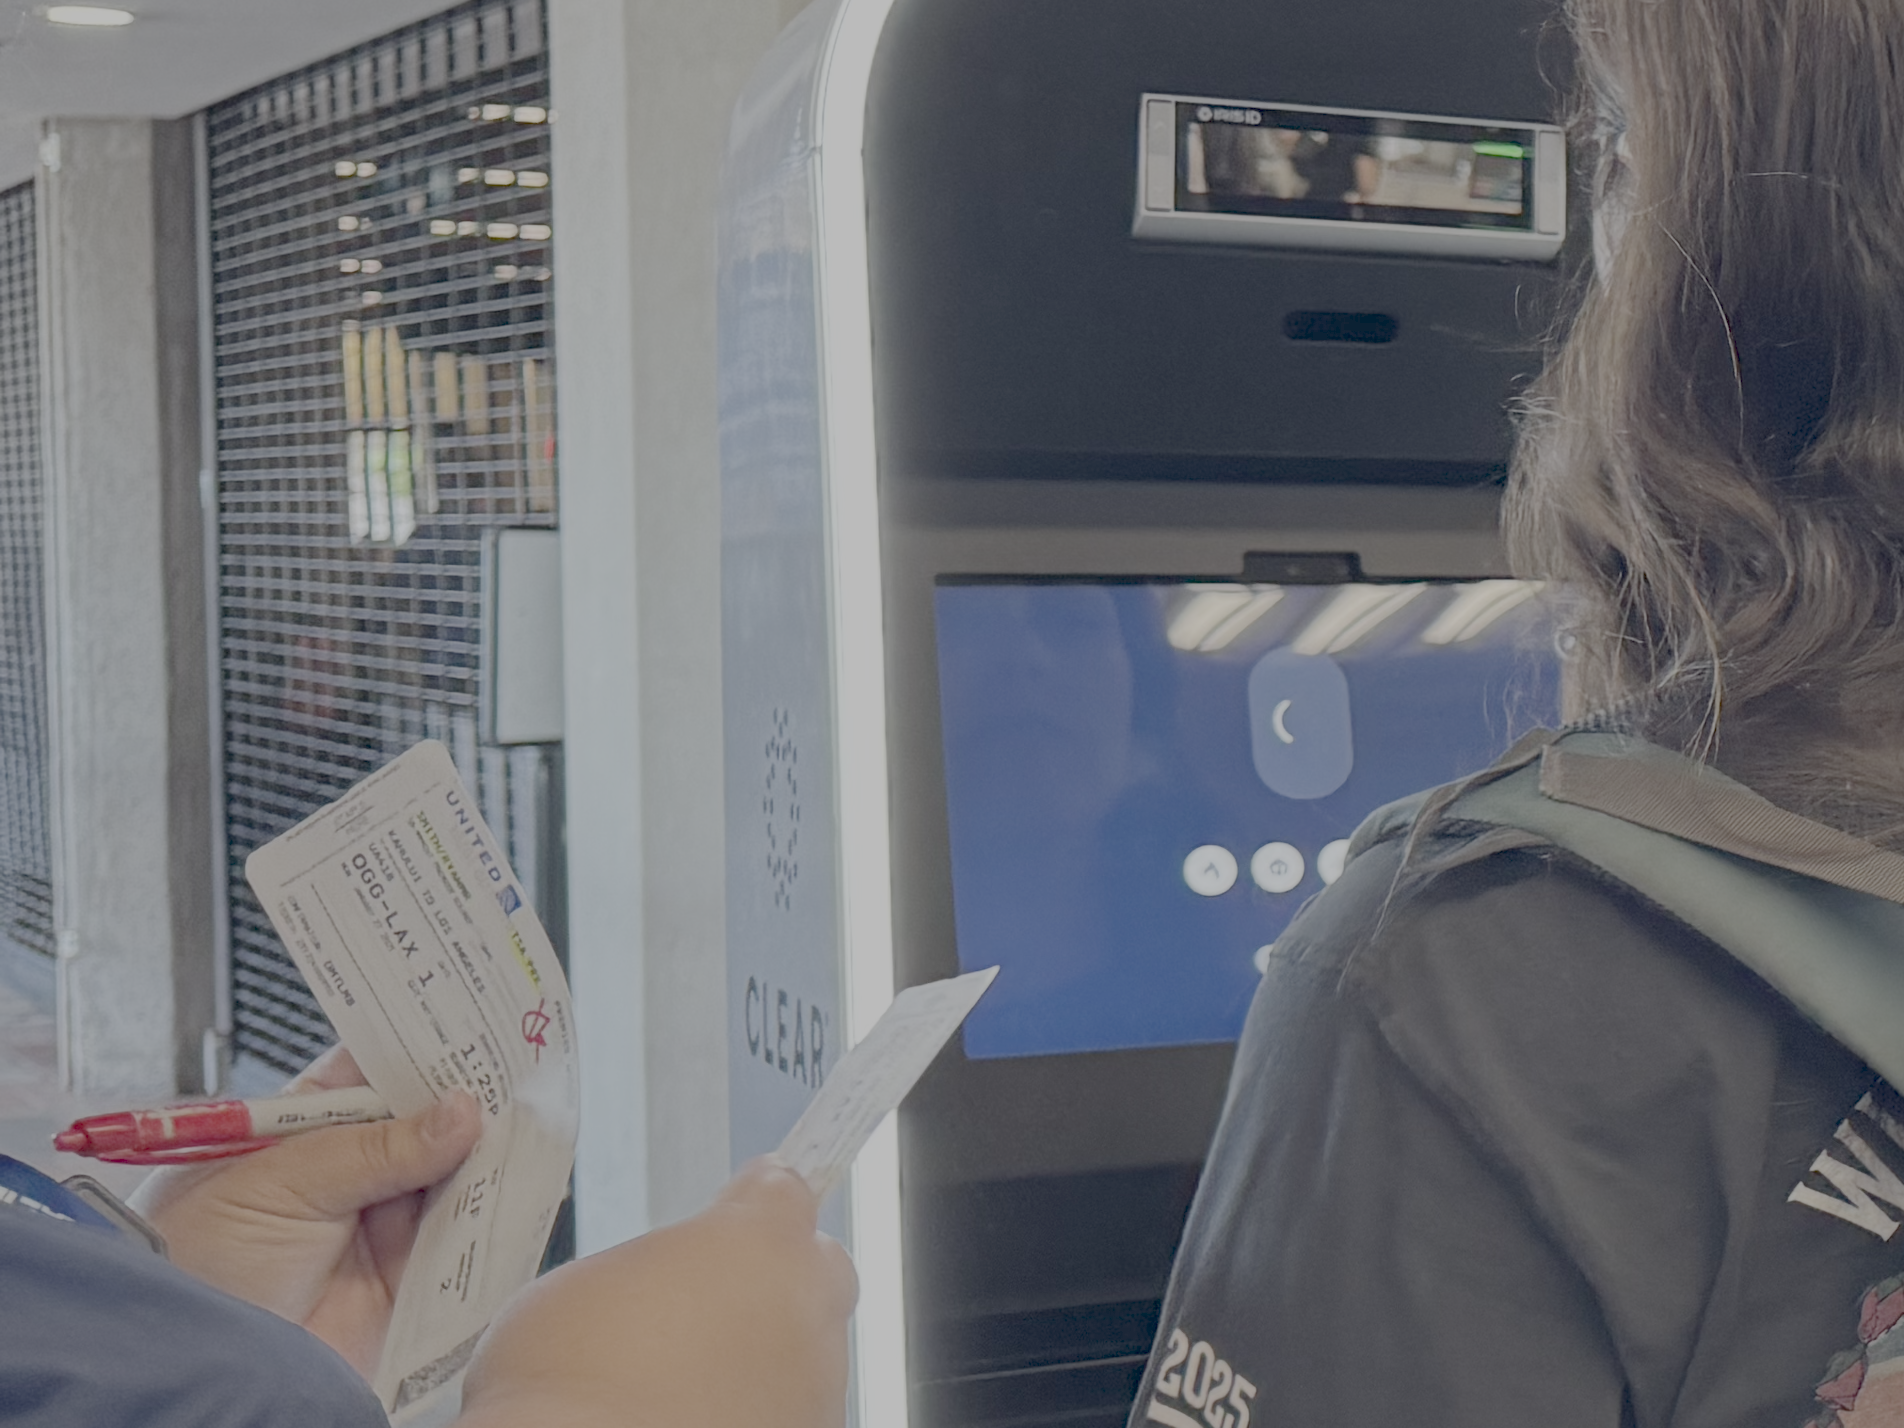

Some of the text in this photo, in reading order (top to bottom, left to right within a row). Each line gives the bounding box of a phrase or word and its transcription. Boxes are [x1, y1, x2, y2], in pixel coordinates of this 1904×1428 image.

[442, 789, 503, 883] UNITED
[344, 851, 420, 959] OGG-LAX
[416, 969, 437, 987] 1
[745, 974, 824, 1090] CLEAR
